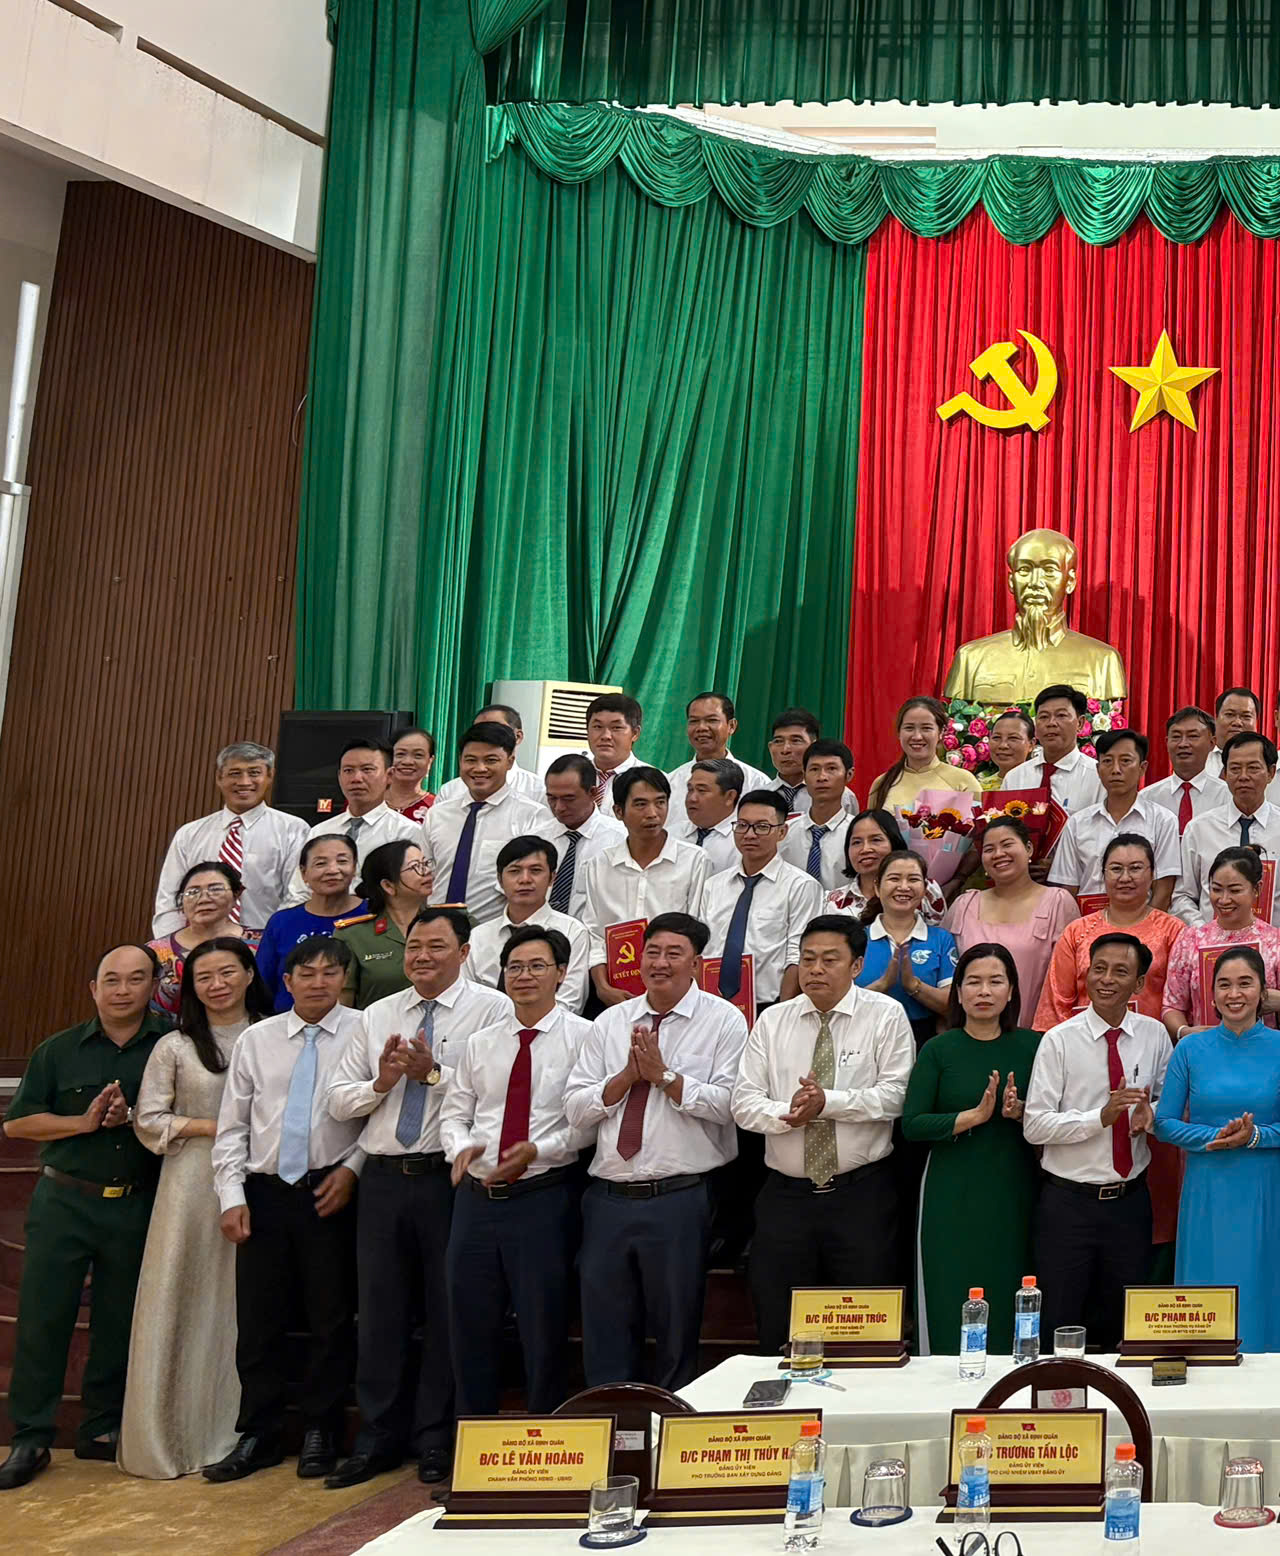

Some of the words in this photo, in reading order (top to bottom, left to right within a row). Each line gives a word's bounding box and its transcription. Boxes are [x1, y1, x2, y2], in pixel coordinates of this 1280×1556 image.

[836, 1313, 864, 1324] THANH
[1161, 1312, 1187, 1324] PHẠM
[1189, 1310, 1200, 1322] BÁ
[1203, 1311, 1216, 1324] LỢI
[480, 1453, 499, 1466] Đ/C
[502, 1450, 516, 1466] LÊ
[519, 1450, 541, 1465] VĂN
[545, 1450, 584, 1465] HOÀNG
[680, 1451, 698, 1463] Đ/C
[701, 1449, 732, 1465] PHẠM
[735, 1448, 750, 1464] THỊ
[1060, 1443, 1079, 1461] LỘC
